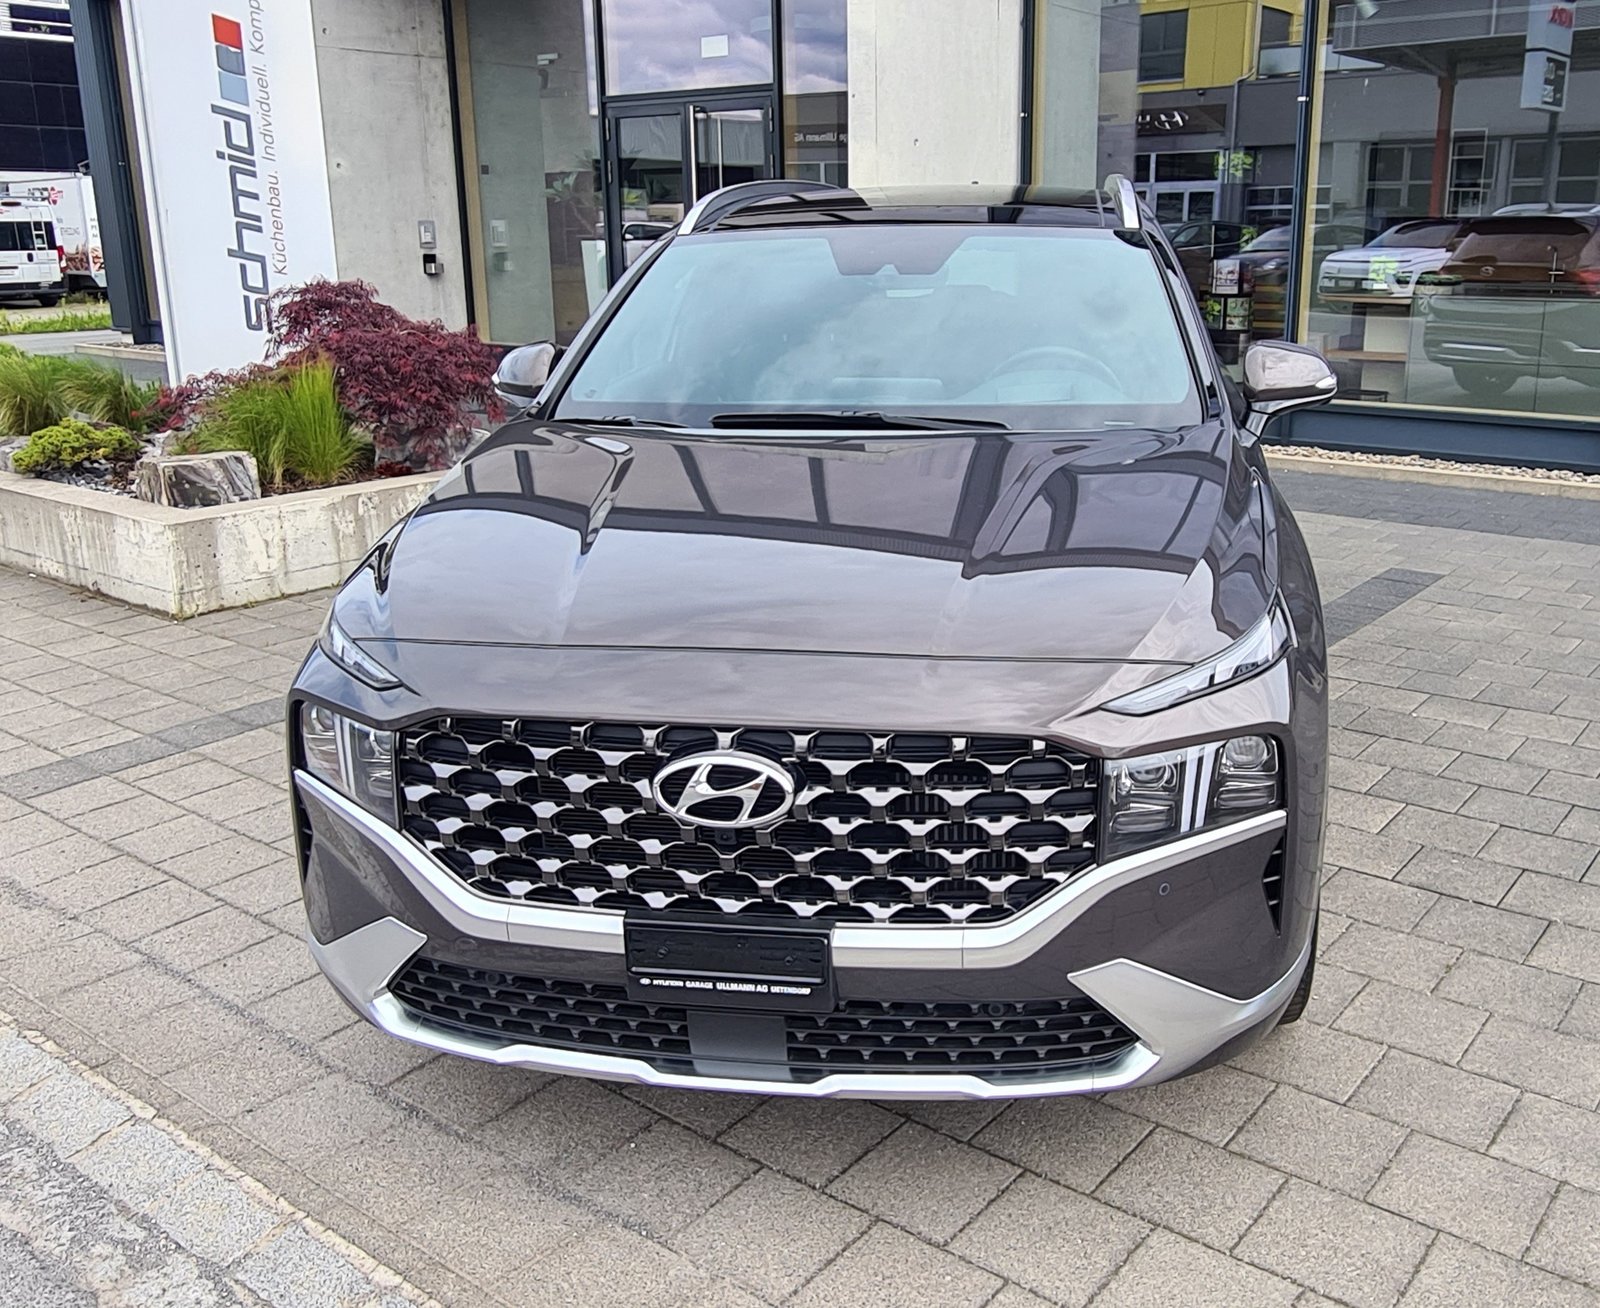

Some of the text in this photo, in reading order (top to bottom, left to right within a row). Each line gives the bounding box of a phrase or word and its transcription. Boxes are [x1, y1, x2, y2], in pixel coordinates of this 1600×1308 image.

[251, 64, 276, 162] Individuell.
[210, 103, 274, 333] schmid
[266, 170, 288, 275] Küchenbau.
[685, 981, 714, 990] GARAGE
[716, 982, 755, 992] ULLMANN
[756, 984, 769, 993] AG
